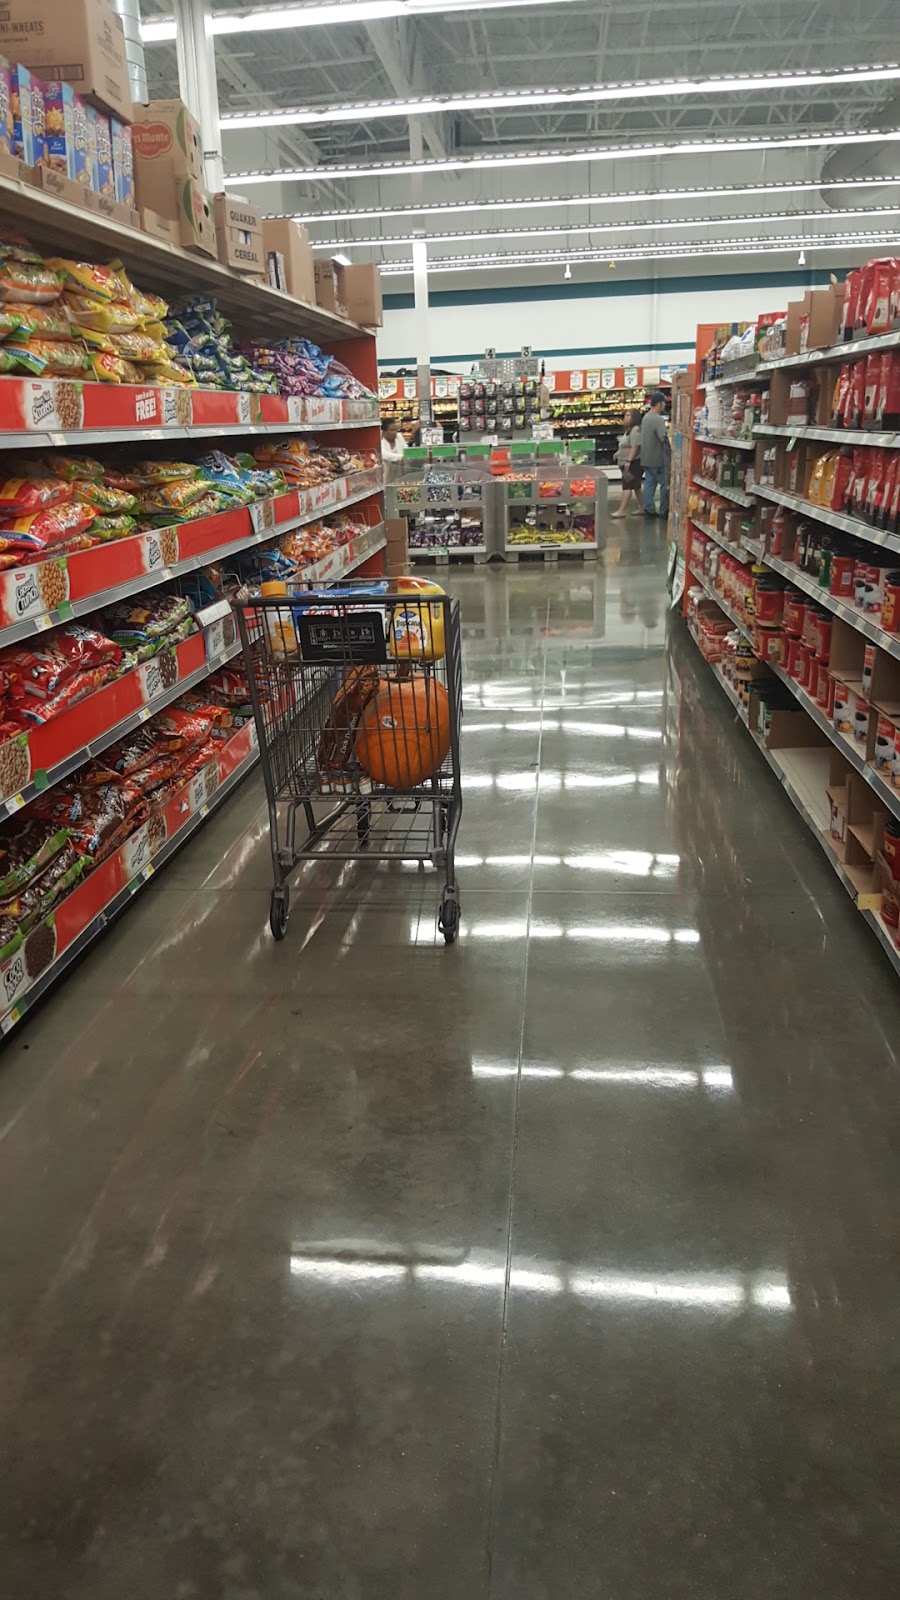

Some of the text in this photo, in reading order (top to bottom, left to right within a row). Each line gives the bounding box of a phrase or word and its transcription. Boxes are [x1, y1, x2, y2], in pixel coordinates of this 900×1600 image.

[142, 132, 169, 143] Monte
[229, 210, 257, 226] QUAKER
[234, 248, 259, 263] CEREAL
[487, 349, 494, 359] 4
[135, 397, 157, 422] FREE!
[396, 620, 421, 628] Tropcana
